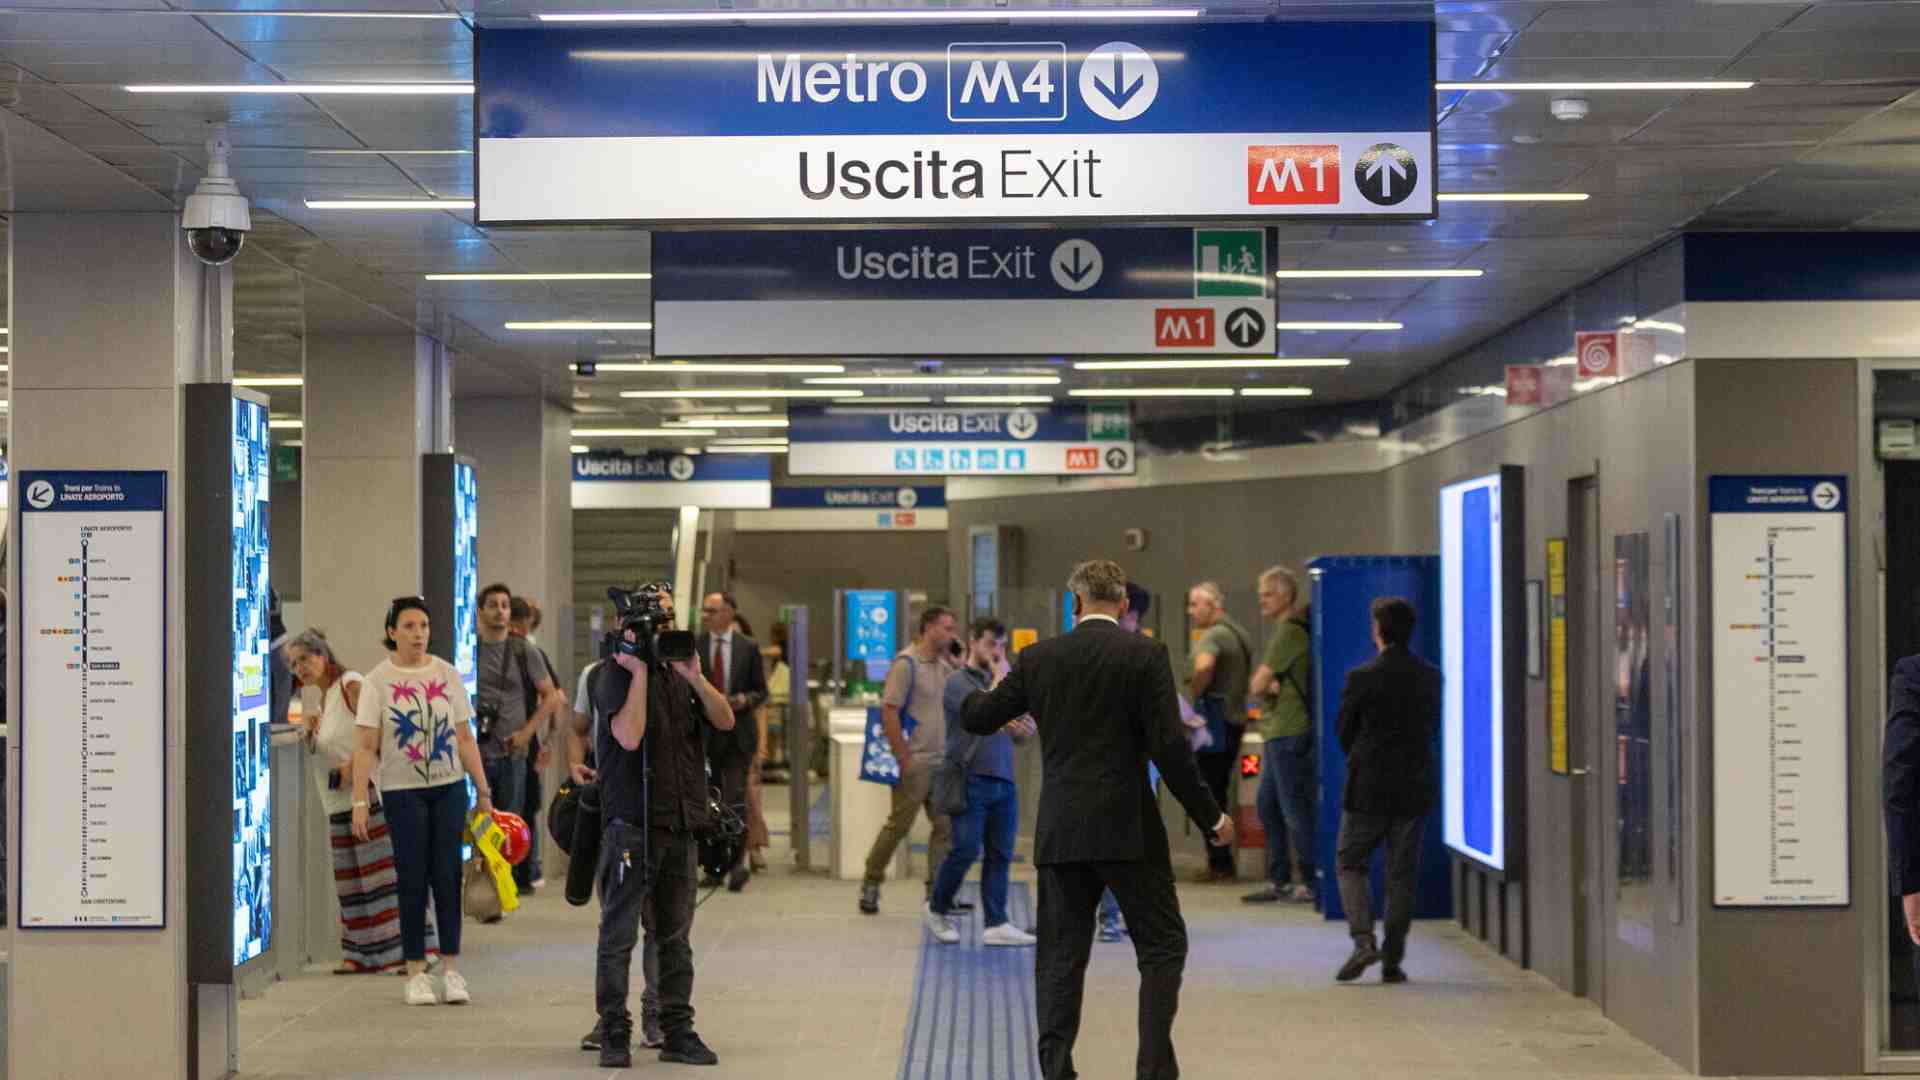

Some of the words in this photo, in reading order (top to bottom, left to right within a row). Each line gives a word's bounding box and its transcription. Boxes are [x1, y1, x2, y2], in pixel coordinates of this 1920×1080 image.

[757, 53, 928, 103] Metro
[959, 60, 1055, 104] M4
[799, 150, 985, 201] Uscita
[1000, 149, 1103, 199] Exit
[1255, 157, 1326, 193] M1
[837, 245, 959, 280] Uscita
[967, 245, 1037, 279] Exit
[1161, 315, 1207, 340] M1
[889, 413, 959, 434] Uscita
[961, 413, 1001, 433] Exit
[576, 458, 632, 477] Uscita
[634, 458, 665, 476] Exit
